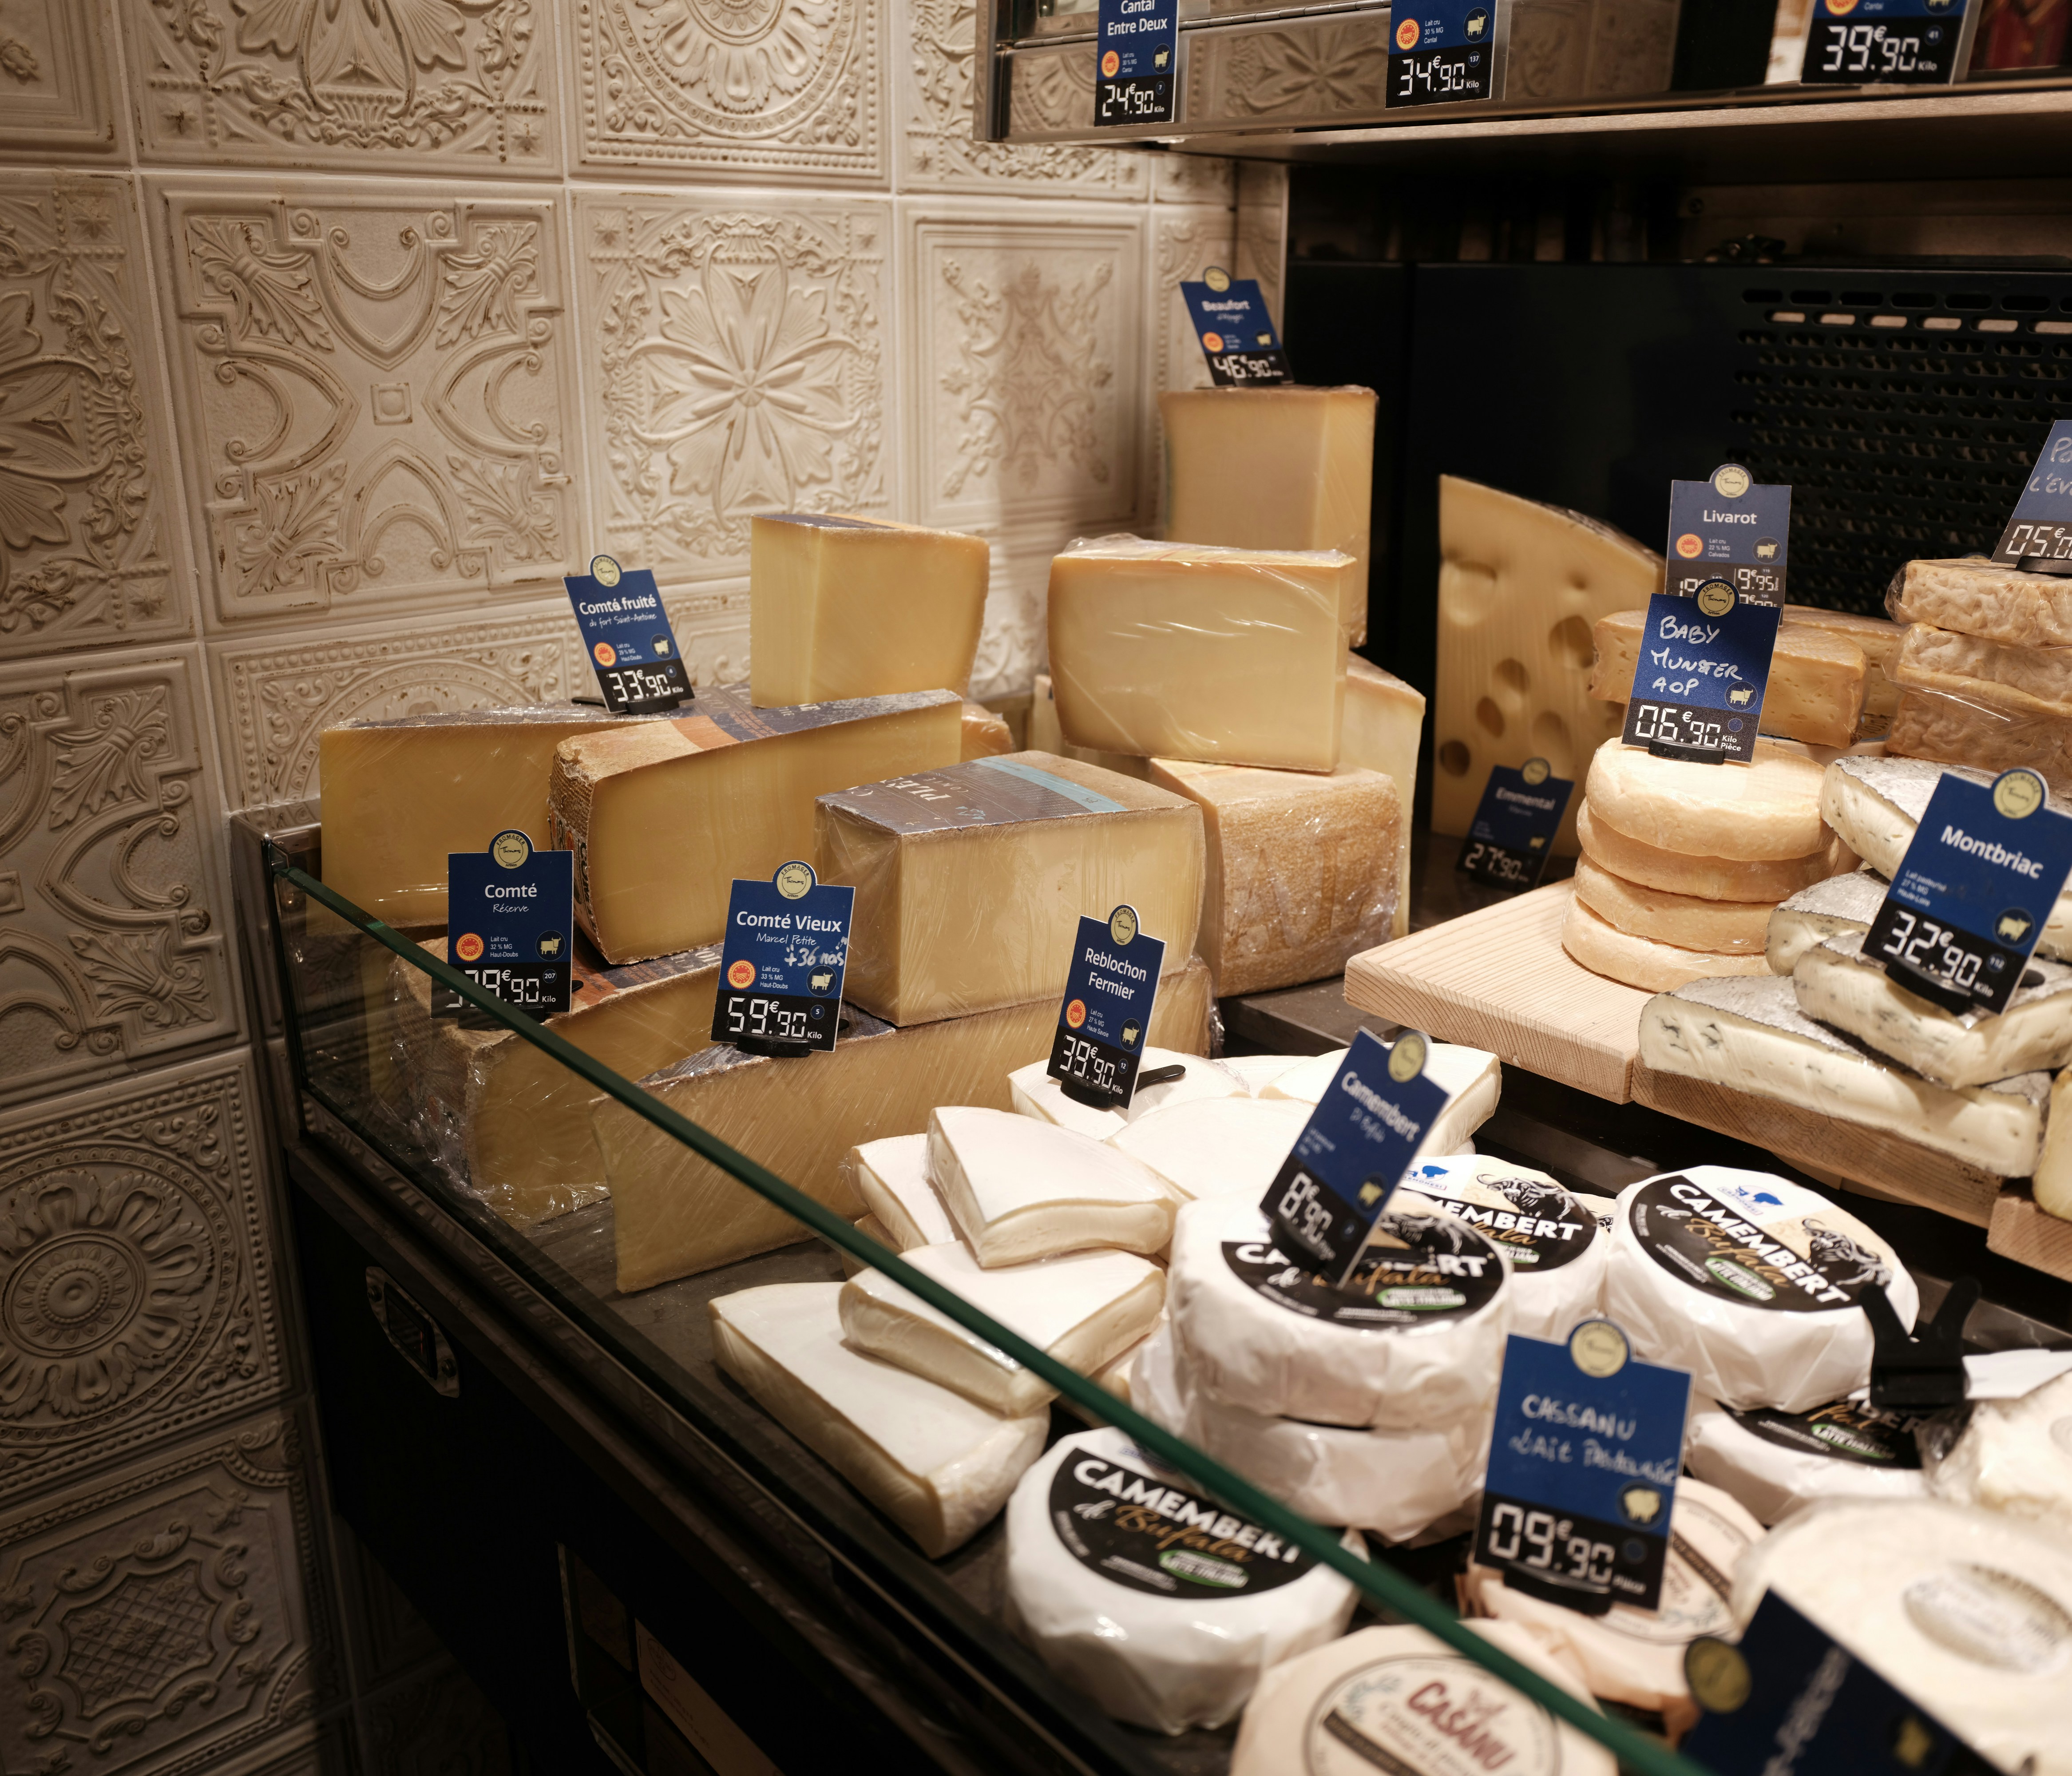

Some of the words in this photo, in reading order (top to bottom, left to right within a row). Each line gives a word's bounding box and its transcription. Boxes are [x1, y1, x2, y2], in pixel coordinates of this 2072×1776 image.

[1121, 0, 1154, 14] Cantal
[1107, 22, 1137, 36] Entre
[1139, 18, 1168, 32] Deux
[1917, 61, 1937, 71] Kilo
[1201, 299, 1251, 312] Beaufort
[1703, 510, 1757, 524] Livarot
[1703, 583, 1733, 595] FROMAGER
[579, 598, 621, 615] Comté
[622, 594, 657, 610] fruité
[1705, 594, 1727, 603] Thomas
[599, 618, 612, 629] fort
[1660, 615, 1720, 644] BABY
[1652, 677, 1699, 696] AOP
[1720, 742, 1742, 751] Pièce
[1496, 786, 1556, 811] Emmental
[496, 834, 526, 846] FROMAGER
[1940, 825, 2044, 880] Montbriac
[781, 864, 810, 877] FROMAGER
[484, 884, 537, 899] Comté
[493, 904, 529, 913] Réserve
[737, 911, 791, 929] Comté
[796, 916, 842, 932] Vieux
[1115, 910, 1135, 924] FROMAGER
[756, 932, 788, 944] Marcel
[792, 935, 817, 946] Petite
[1085, 947, 1147, 982] Reblochon
[1088, 972, 1135, 1000] Fermier
[1974, 982, 1994, 997] Kilo
[1097, 1028, 1109, 1038] Savoie
[1112, 1084, 1123, 1094] Kilo
[1341, 1071, 1420, 1142] Camembert
[1670, 1184, 1850, 1303] CAMEMBERT
[1685, 1218, 1790, 1288] Bufala
[1114, 1504, 1254, 1563] Bufala
[1407, 1682, 1515, 1771] CASANU
